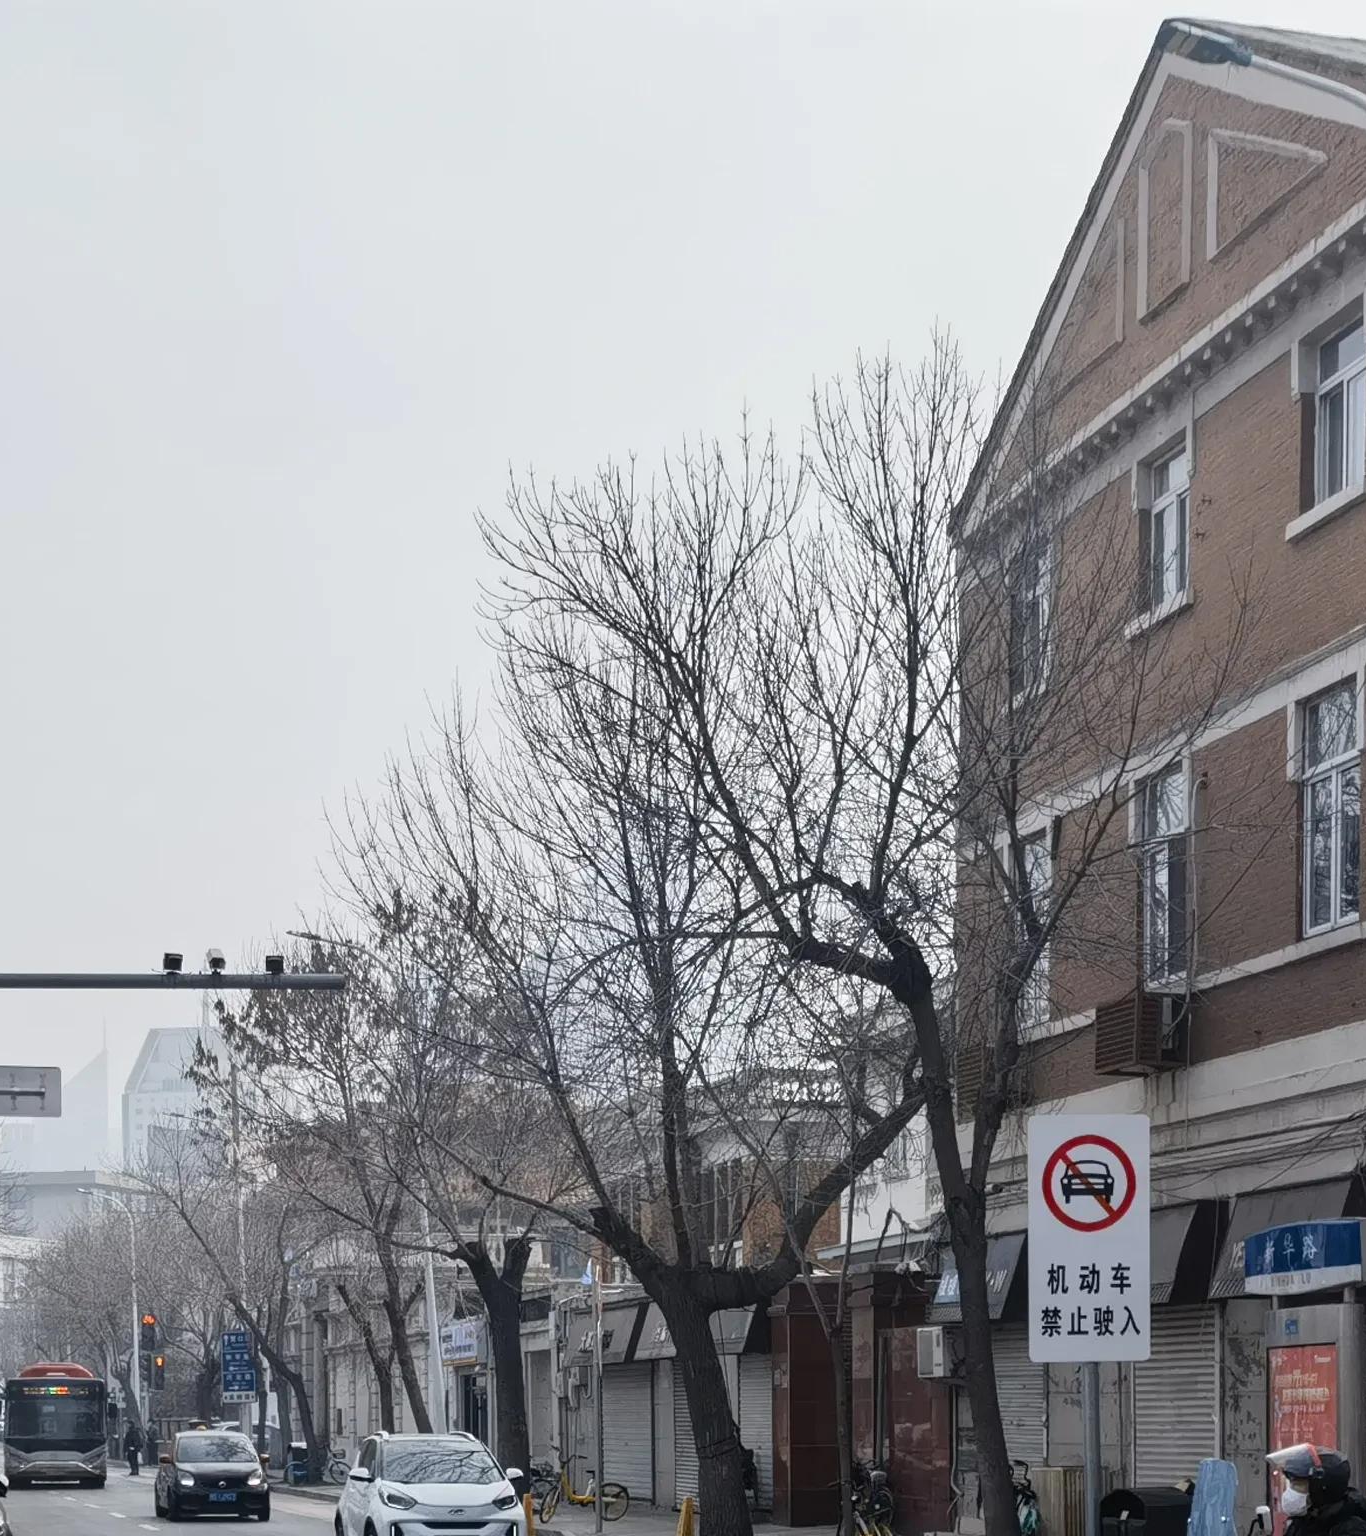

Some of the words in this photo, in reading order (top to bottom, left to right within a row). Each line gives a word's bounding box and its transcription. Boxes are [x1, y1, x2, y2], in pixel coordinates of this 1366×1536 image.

[1047, 1263, 1132, 1295] 机动车
[1041, 1305, 1142, 1337] 禁止驶入
